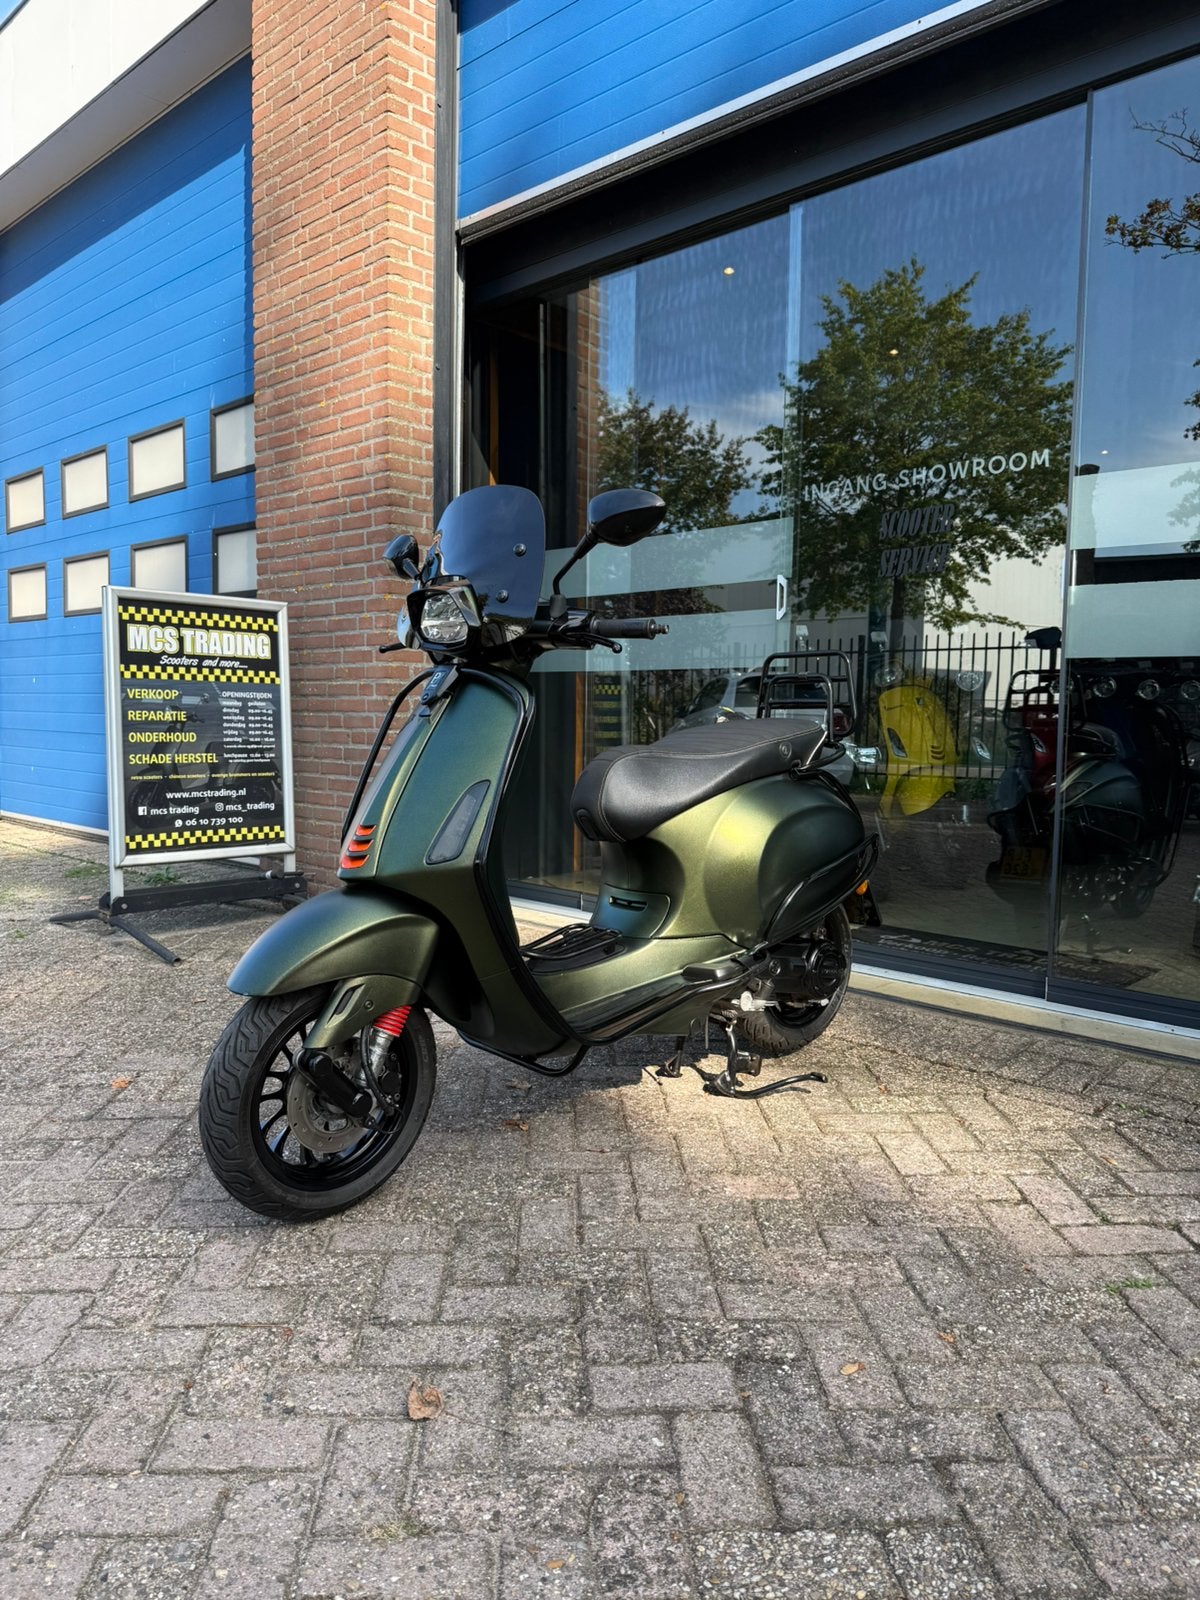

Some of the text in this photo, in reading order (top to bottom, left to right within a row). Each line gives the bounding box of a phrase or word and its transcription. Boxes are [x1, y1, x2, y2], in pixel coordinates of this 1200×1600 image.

[804, 449, 1050, 501] INGANG SHOWROOM
[880, 504, 955, 540] SCOOTER
[128, 624, 271, 659] MCS TRADING
[160, 656, 198, 667] Scooters
[202, 658, 219, 667] and
[127, 689, 179, 700] VERKOOP
[222, 691, 272, 700] OPENINGSTIJDEN
[128, 711, 187, 721] REPARATIE
[128, 732, 197, 743] ONDERHOUD
[129, 754, 172, 765] SCHADE
[175, 753, 218, 763] HERSTEL
[166, 788, 246, 799] www.mcstrading.nl
[169, 806, 199, 815] trading
[226, 802, 275, 811] mcs_trading
[211, 818, 226, 826] 739
